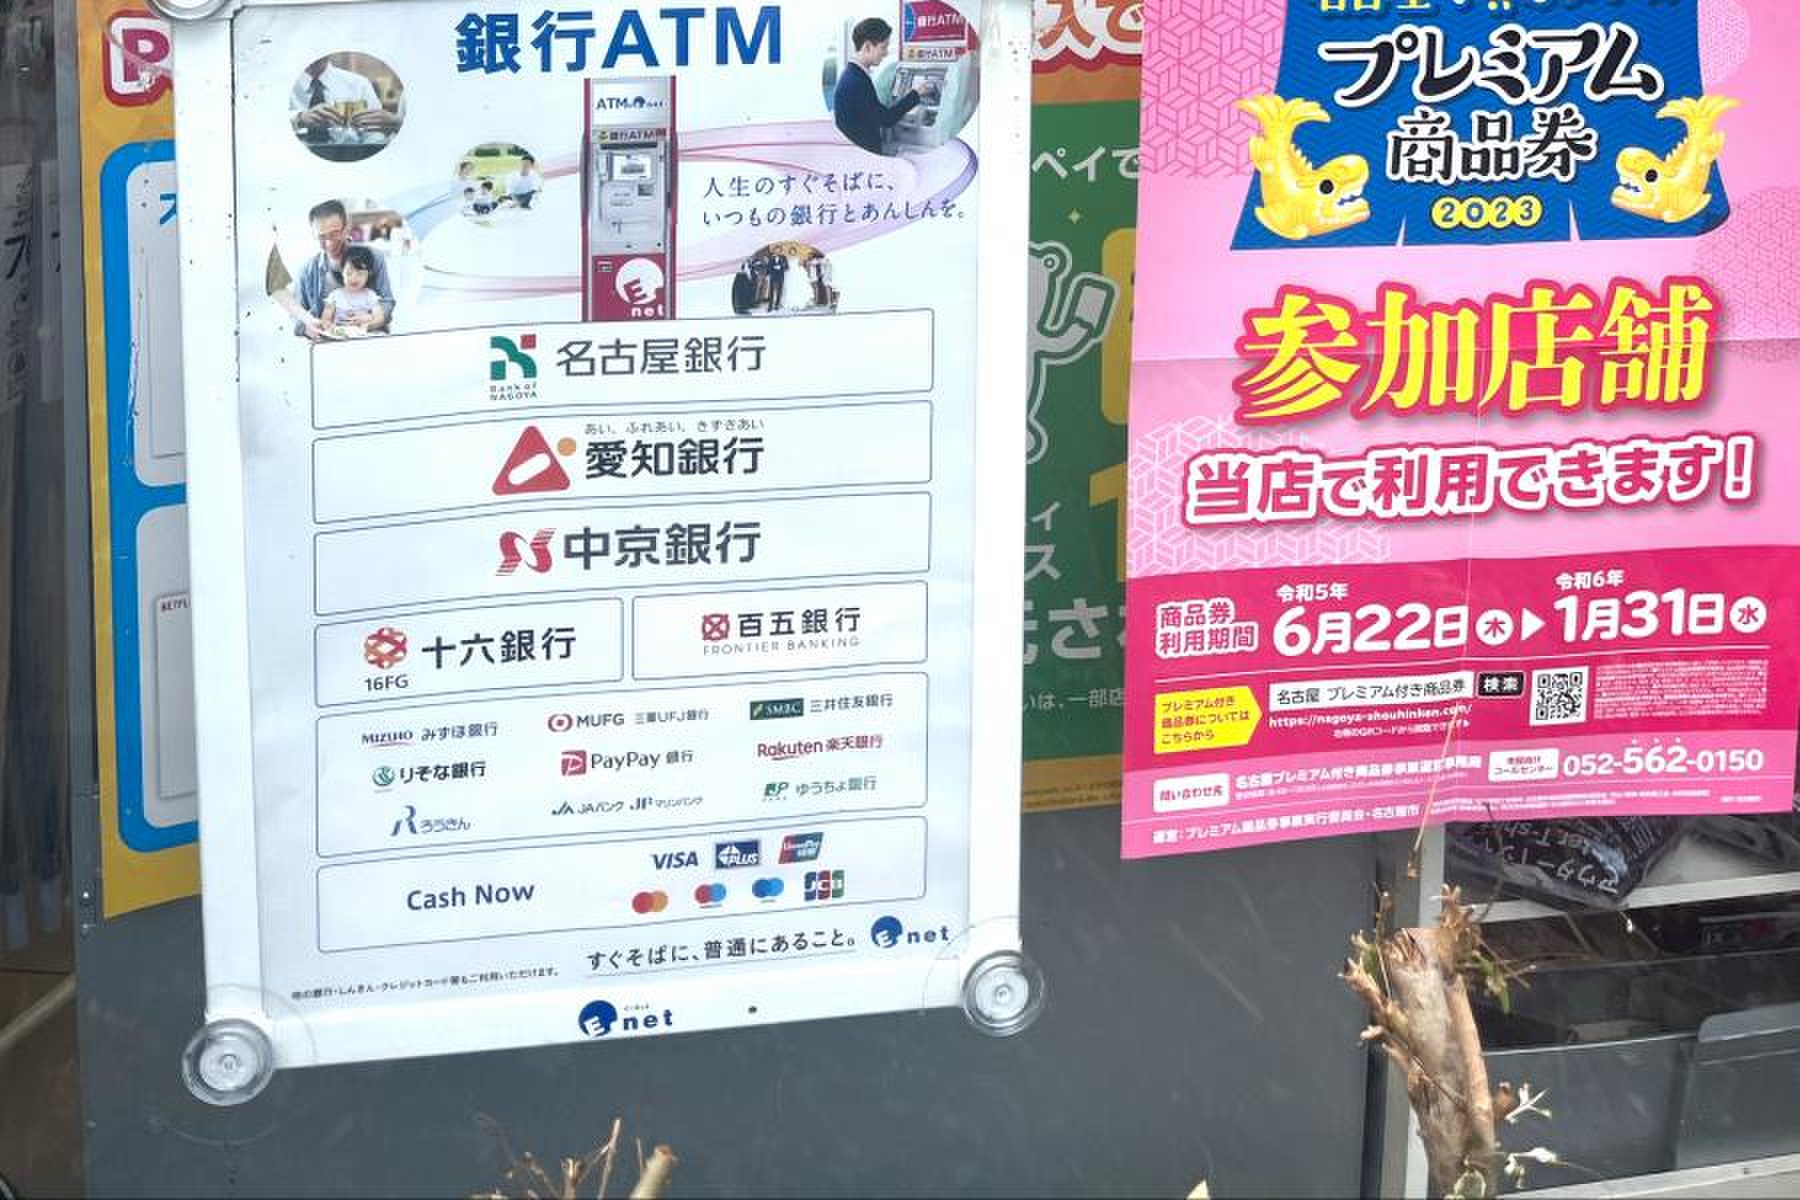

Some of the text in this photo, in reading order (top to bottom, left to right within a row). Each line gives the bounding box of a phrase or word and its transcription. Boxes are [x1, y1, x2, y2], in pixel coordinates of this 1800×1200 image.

[456, 3, 783, 75] 銀行ATM
[1321, 24, 1663, 103] プレミアム
[1388, 106, 1596, 181] 商品券
[702, 171, 897, 199] 人生のすぐそばに、
[702, 198, 966, 227] いつもの銀行とあんしんを。
[1433, 197, 1543, 228] 2023
[556, 334, 767, 377] 名古屋銀行
[1240, 283, 1714, 422] 参加店舗
[585, 435, 765, 482] 愛知銀行
[1188, 435, 1756, 524] 当店で利用できます!
[563, 521, 762, 571] 中京銀行
[1276, 581, 1349, 603] 令和5年
[1555, 569, 1625, 591] 令和6年
[737, 606, 863, 637] 百五銀行
[1159, 601, 1232, 628] 商品券
[1553, 588, 1725, 643] 1月31日
[1158, 625, 1256, 655] 利用期間
[1272, 602, 1469, 657] 6月22日
[421, 625, 577, 670] 十六銀行
[703, 636, 862, 657] FRONTIER BANKING
[363, 673, 410, 693] 16FG
[1277, 675, 1520, 705] 名古屋 プレミアム付き商品券 検索
[810, 693, 894, 713] 三井住友銀行
[361, 721, 498, 744] MIZUHO みずほ銀行
[576, 713, 625, 728] MUFG
[590, 750, 694, 771] PayPay 銀行
[757, 734, 884, 758] Rakuten 楽天銀行
[399, 761, 487, 784] りそな銀行
[1563, 745, 1764, 777] 052-562-0150
[796, 776, 878, 797] ゆうちょ銀行
[420, 815, 472, 834] ろうきん
[652, 851, 699, 870] VISA
[406, 882, 535, 912] Cash Now
[907, 924, 949, 944] net
[587, 929, 856, 971] すぐそばに、普通にあること。
[622, 1009, 674, 1031] net
